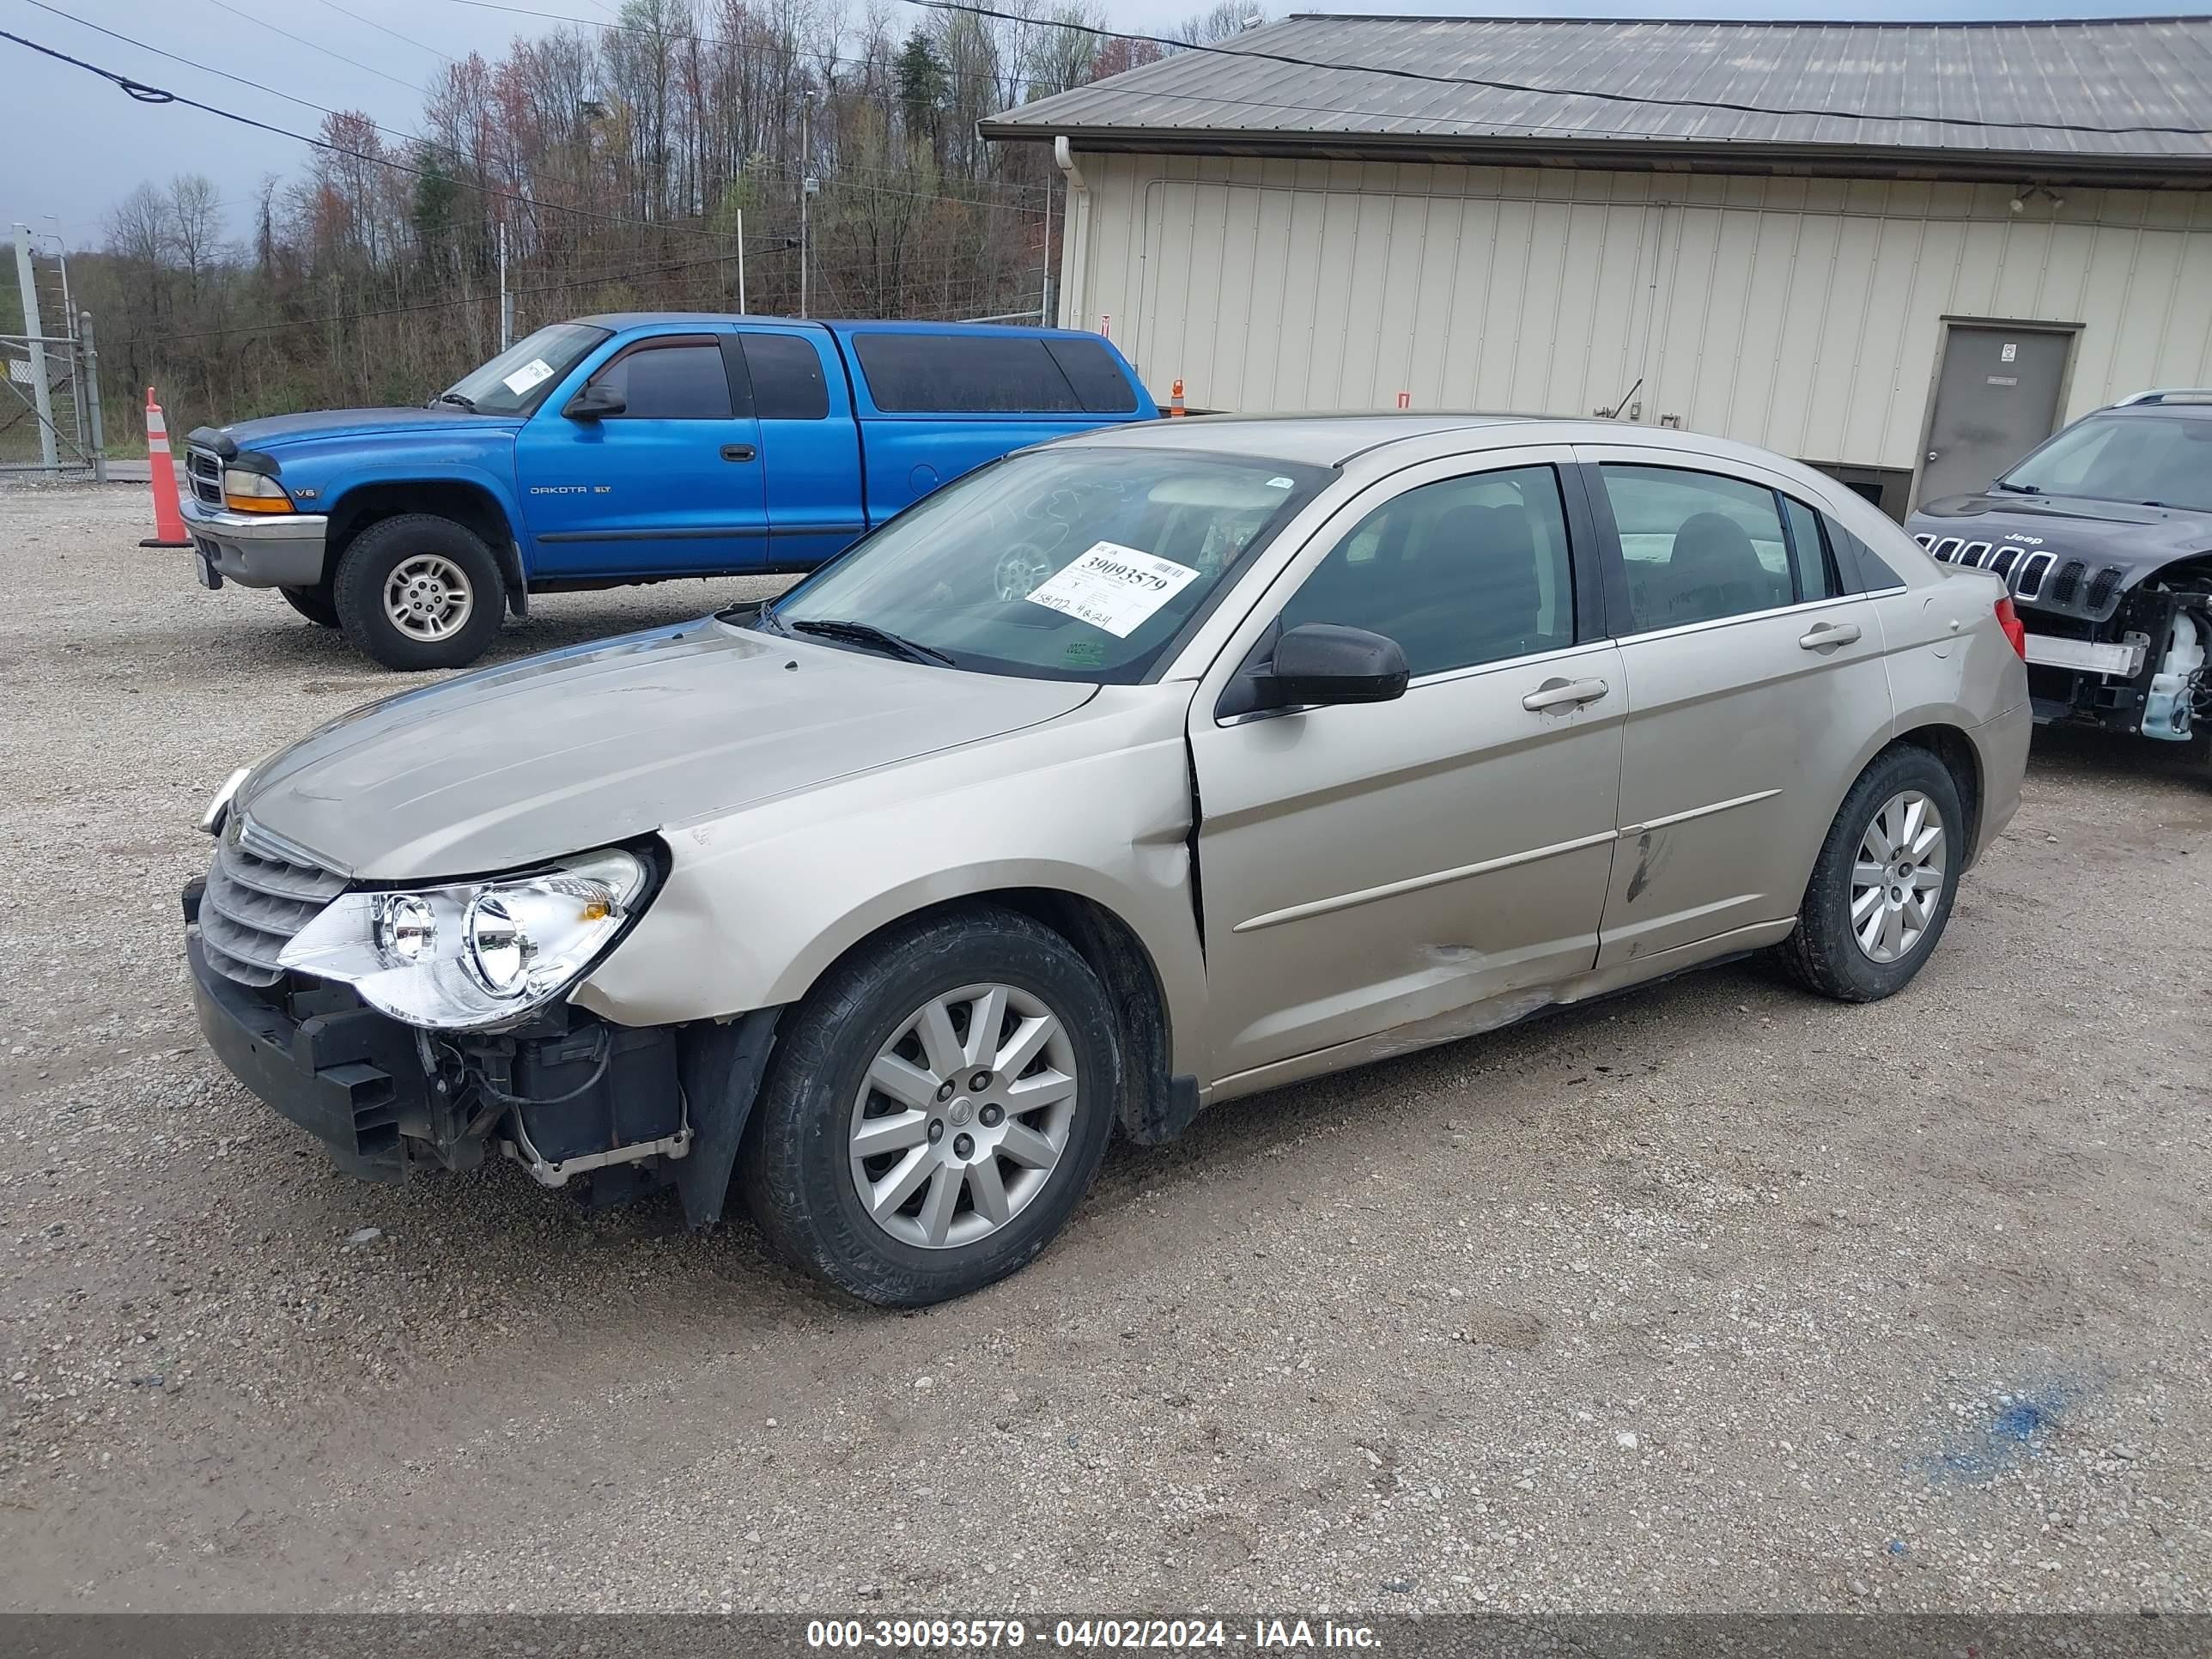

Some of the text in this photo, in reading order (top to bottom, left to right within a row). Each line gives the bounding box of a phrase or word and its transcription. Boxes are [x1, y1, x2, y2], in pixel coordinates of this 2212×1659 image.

[530, 486, 587, 495] DAKOTA
[2004, 533, 2044, 545] Jeep
[1081, 556, 1169, 592] 39093579
